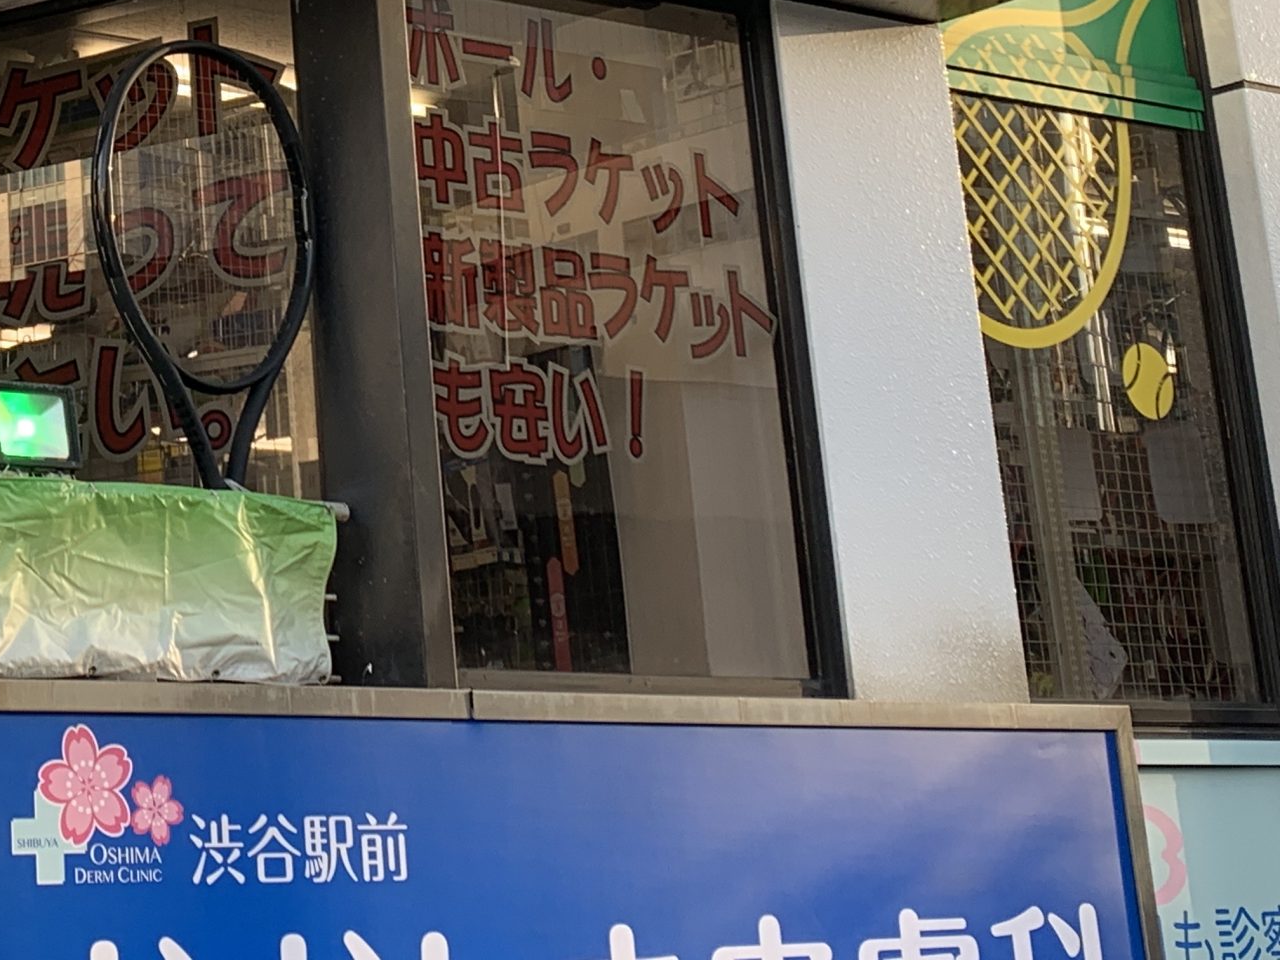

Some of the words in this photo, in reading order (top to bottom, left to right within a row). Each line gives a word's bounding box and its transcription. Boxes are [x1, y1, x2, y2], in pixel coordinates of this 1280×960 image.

[413, 113, 740, 239] 中古ラケット
[422, 230, 775, 359] 新製品ラケット
[16, 836, 60, 850] SHIBUYA
[90, 843, 162, 865] OSHIMA
[189, 812, 408, 886] 渋谷駅前
[74, 868, 115, 885] DERM
[117, 866, 163, 884] CLINIC
